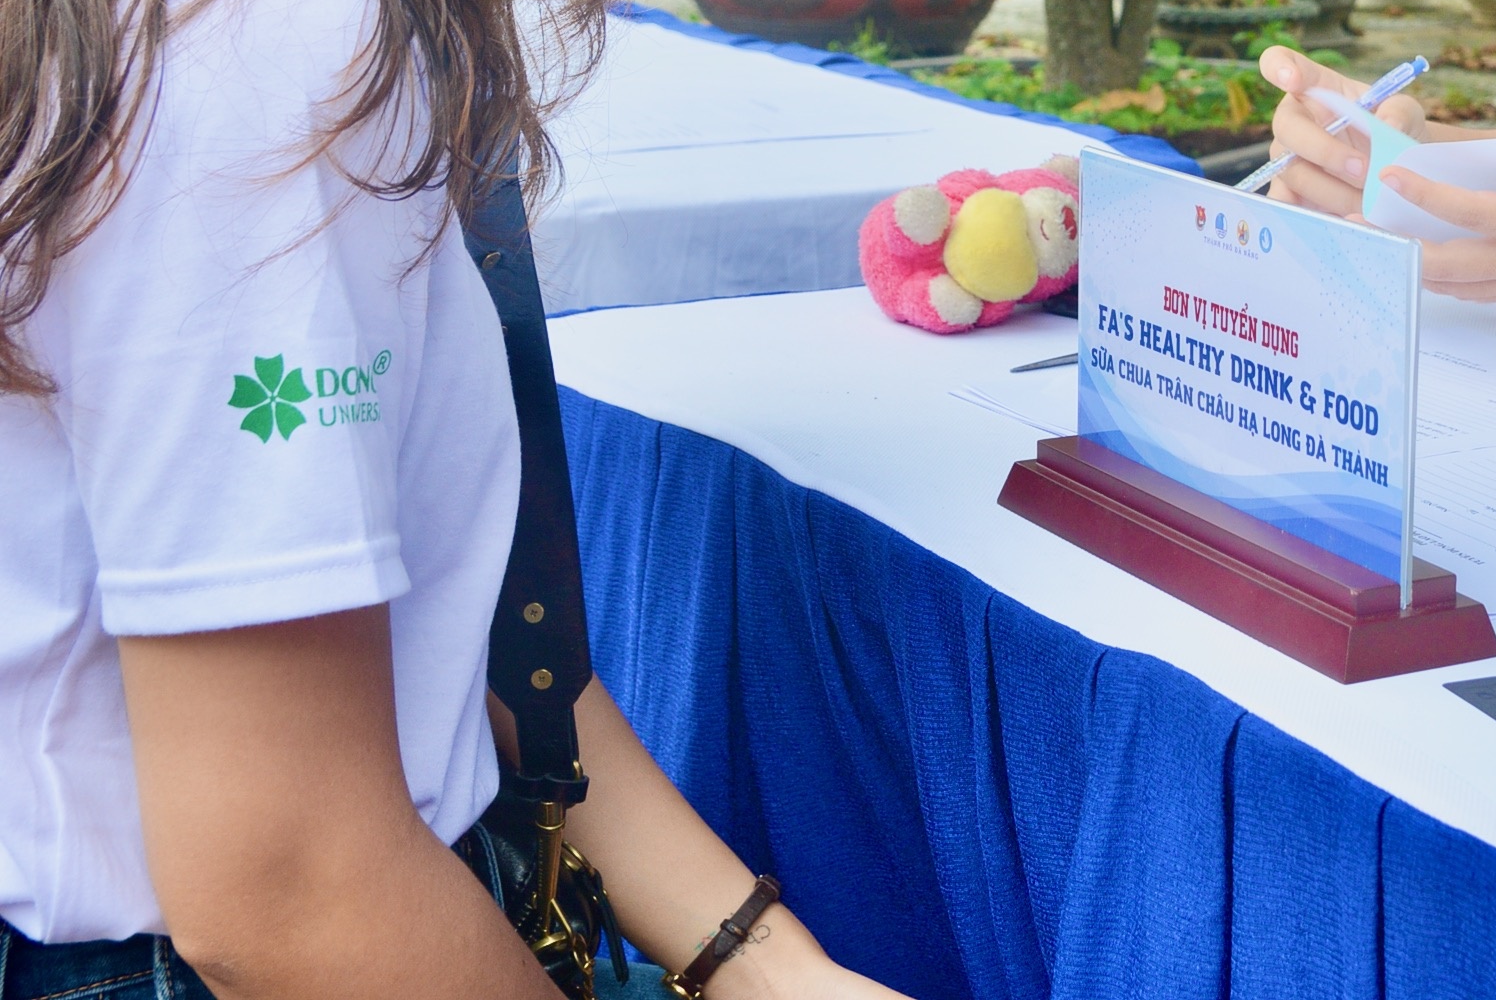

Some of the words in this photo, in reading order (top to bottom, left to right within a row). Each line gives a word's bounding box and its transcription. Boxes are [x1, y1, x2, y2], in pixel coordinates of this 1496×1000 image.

[1098, 303, 1134, 342] FA'S
[1139, 319, 1225, 377] HEALTHY
[1230, 353, 1293, 404] DRINK
[1299, 380, 1317, 414] &
[1323, 388, 1379, 436] FOOD
[1163, 285, 1190, 319] ĐƠN
[1193, 296, 1207, 330] VỊ
[1210, 302, 1258, 343] TUYỂN
[1261, 320, 1299, 358] DỤNG
[1091, 345, 1115, 375] SỮA
[1118, 358, 1153, 391] CHUA
[1156, 376, 1194, 408] TRÂN
[1197, 393, 1235, 423] CHÂU
[1238, 406, 1259, 437] HẠ
[1262, 416, 1301, 452] LONG
[1305, 434, 1327, 463] ĐÀ
[1331, 444, 1389, 488] THÀNH
